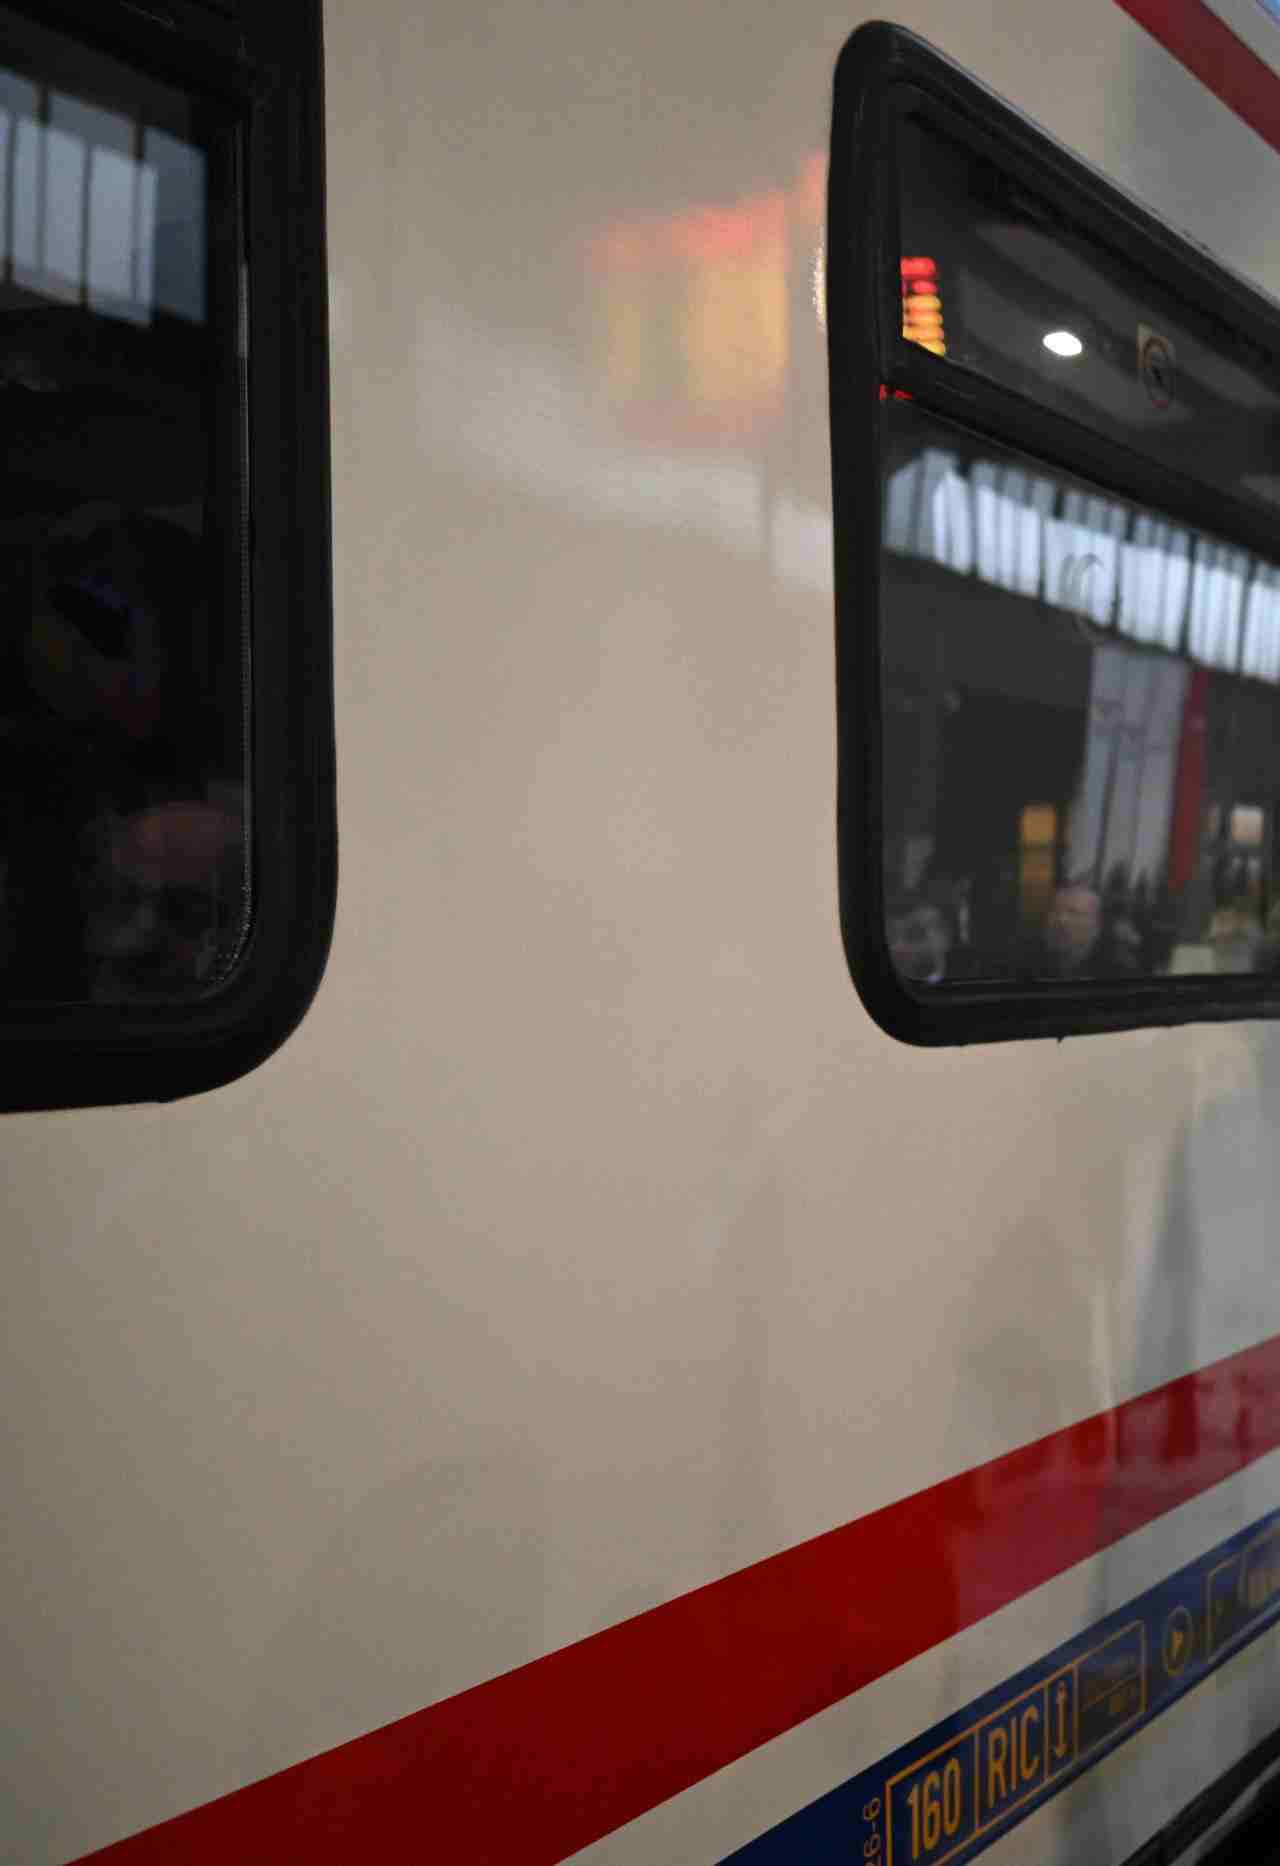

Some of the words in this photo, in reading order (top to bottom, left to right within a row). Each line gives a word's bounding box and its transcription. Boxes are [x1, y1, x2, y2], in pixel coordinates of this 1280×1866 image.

[863, 1797, 881, 1866] 6-6
[907, 1757, 961, 1863] 160
[987, 1705, 1040, 1809] RIC
